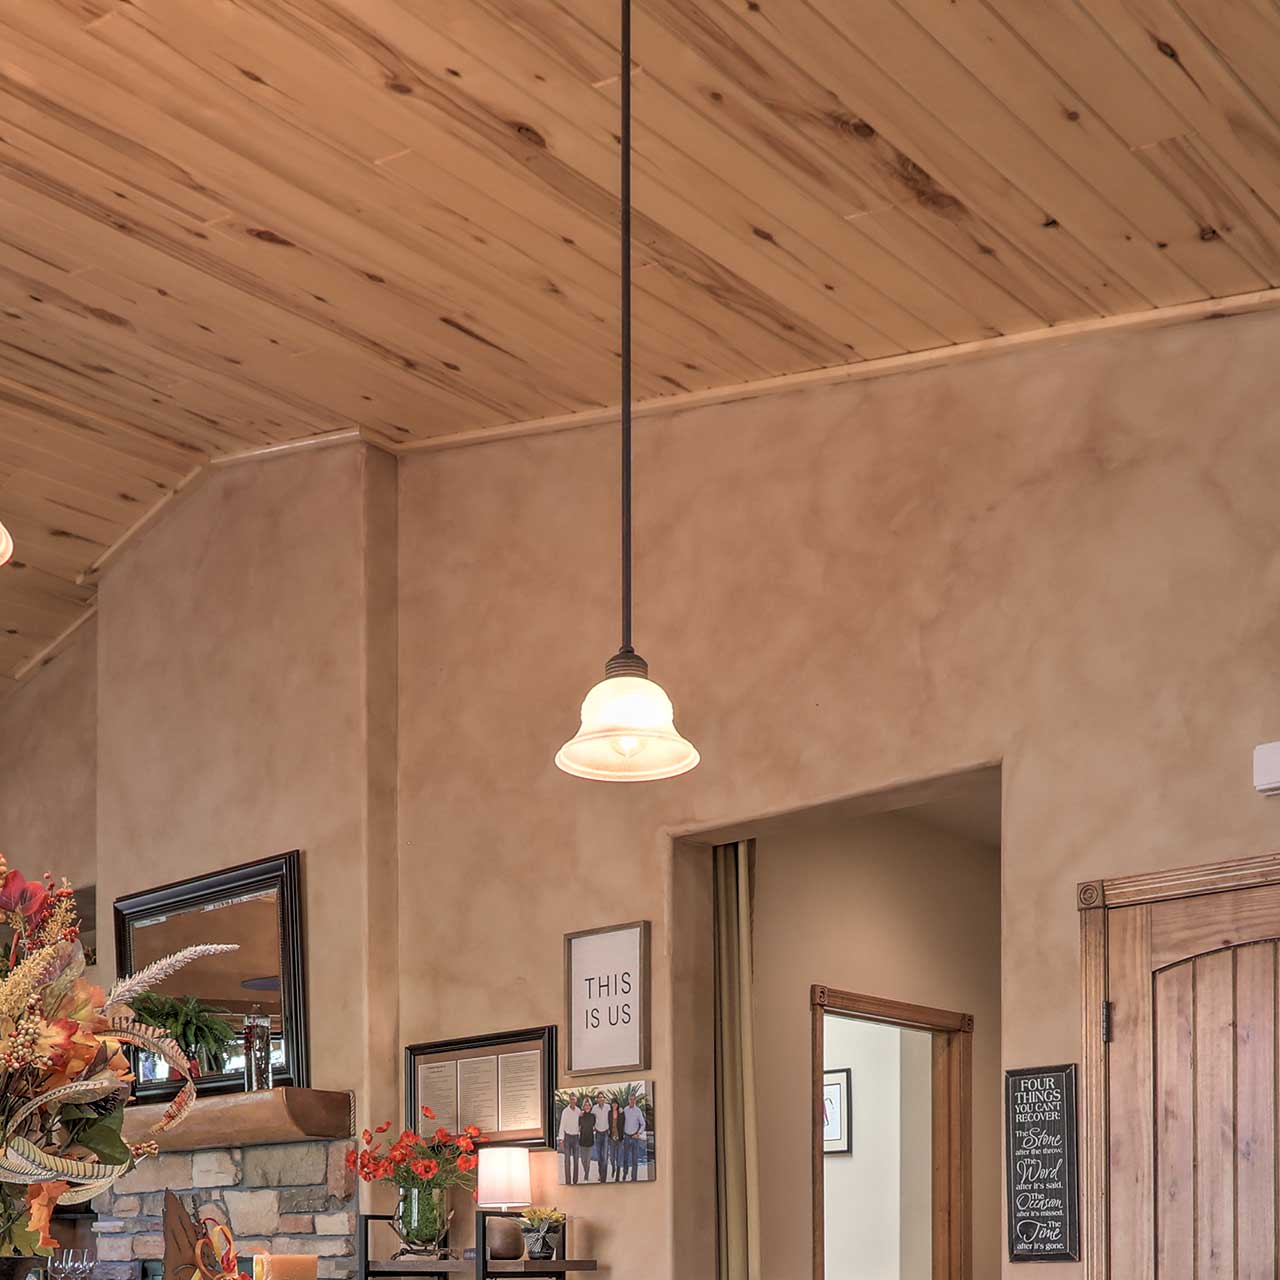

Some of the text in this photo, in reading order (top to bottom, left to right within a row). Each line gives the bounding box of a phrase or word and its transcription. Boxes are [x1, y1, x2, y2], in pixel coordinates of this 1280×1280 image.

[585, 971, 631, 999] THIS
[585, 1004, 631, 1029] IS US
[1021, 1077, 1055, 1091] FOUR
[1015, 1089, 1061, 1103] THINGS
[1015, 1104, 1034, 1113] YOU
[1016, 1112, 1061, 1123] RECOVER:
[1022, 1127, 1063, 1149] Stone
[1017, 1159, 1063, 1184] Word
[1016, 1182, 1032, 1190] after
[1046, 1181, 1063, 1189] said.
[1016, 1192, 1063, 1210] Occasion
[1017, 1219, 1062, 1243] Time
[1047, 1220, 1061, 1228] The
[1016, 1242, 1033, 1250] after
[1045, 1242, 1065, 1250] gone.
